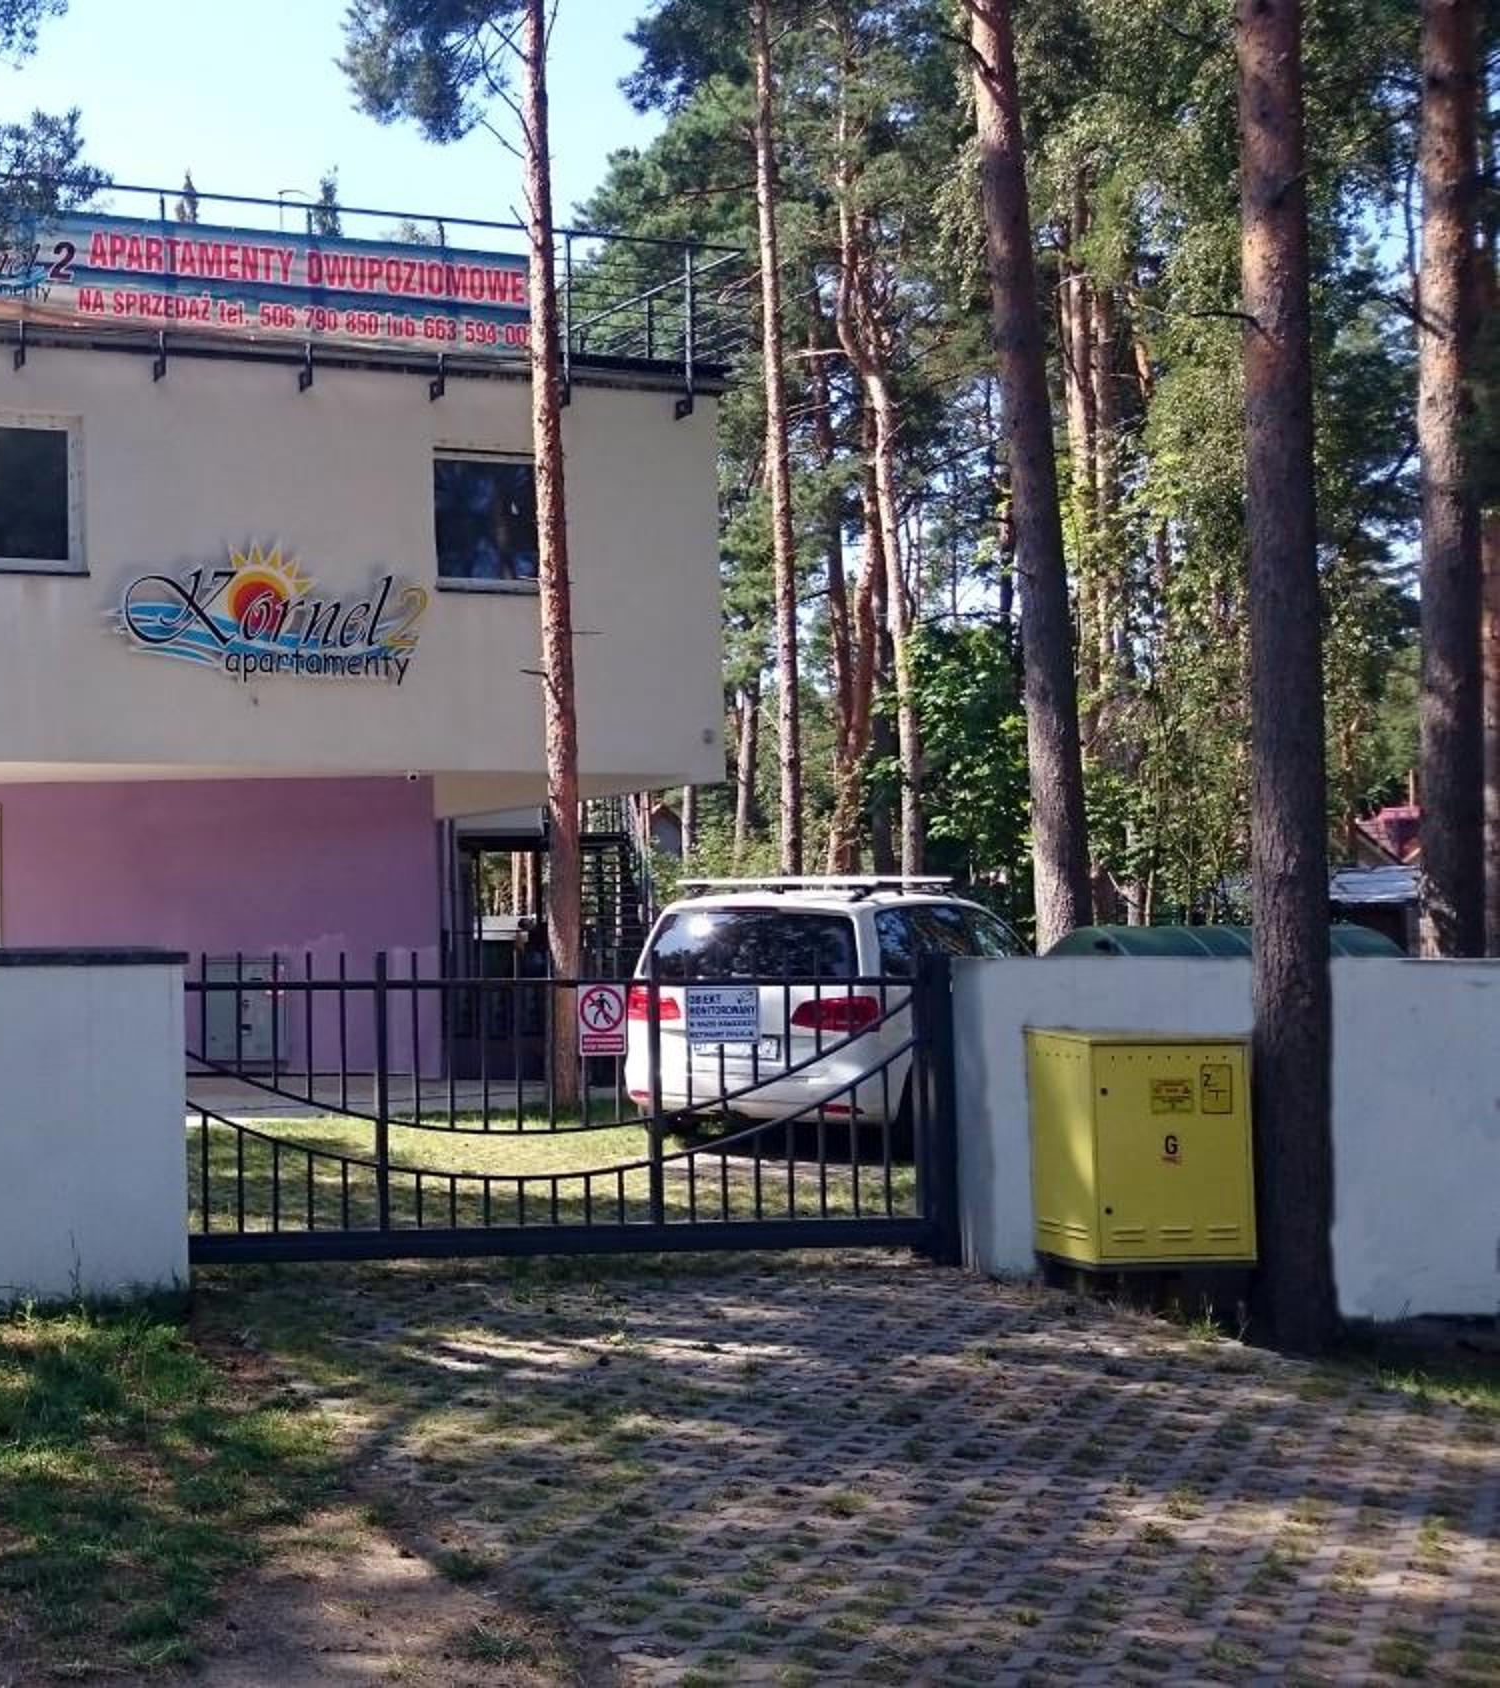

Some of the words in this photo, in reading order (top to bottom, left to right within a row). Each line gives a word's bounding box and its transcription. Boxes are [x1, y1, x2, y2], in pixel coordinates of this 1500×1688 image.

[50, 241, 77, 283] 2
[89, 231, 295, 284] APARTAMENTY
[307, 251, 526, 304] DWUPOZIOMOWE
[79, 288, 104, 313] NA
[113, 290, 211, 321] SPRZEDAŻ
[219, 300, 251, 325] tel.
[259, 304, 296, 329] 506
[303, 307, 338, 332] 790
[387, 314, 416, 337] lub
[423, 317, 457, 341] 663
[465, 321, 498, 345] 594
[505, 325, 533, 347] 00
[125, 568, 393, 648] Kornel
[387, 586, 430, 646] 2
[225, 650, 411, 686] apartamenty
[1164, 1134, 1179, 1155] G
